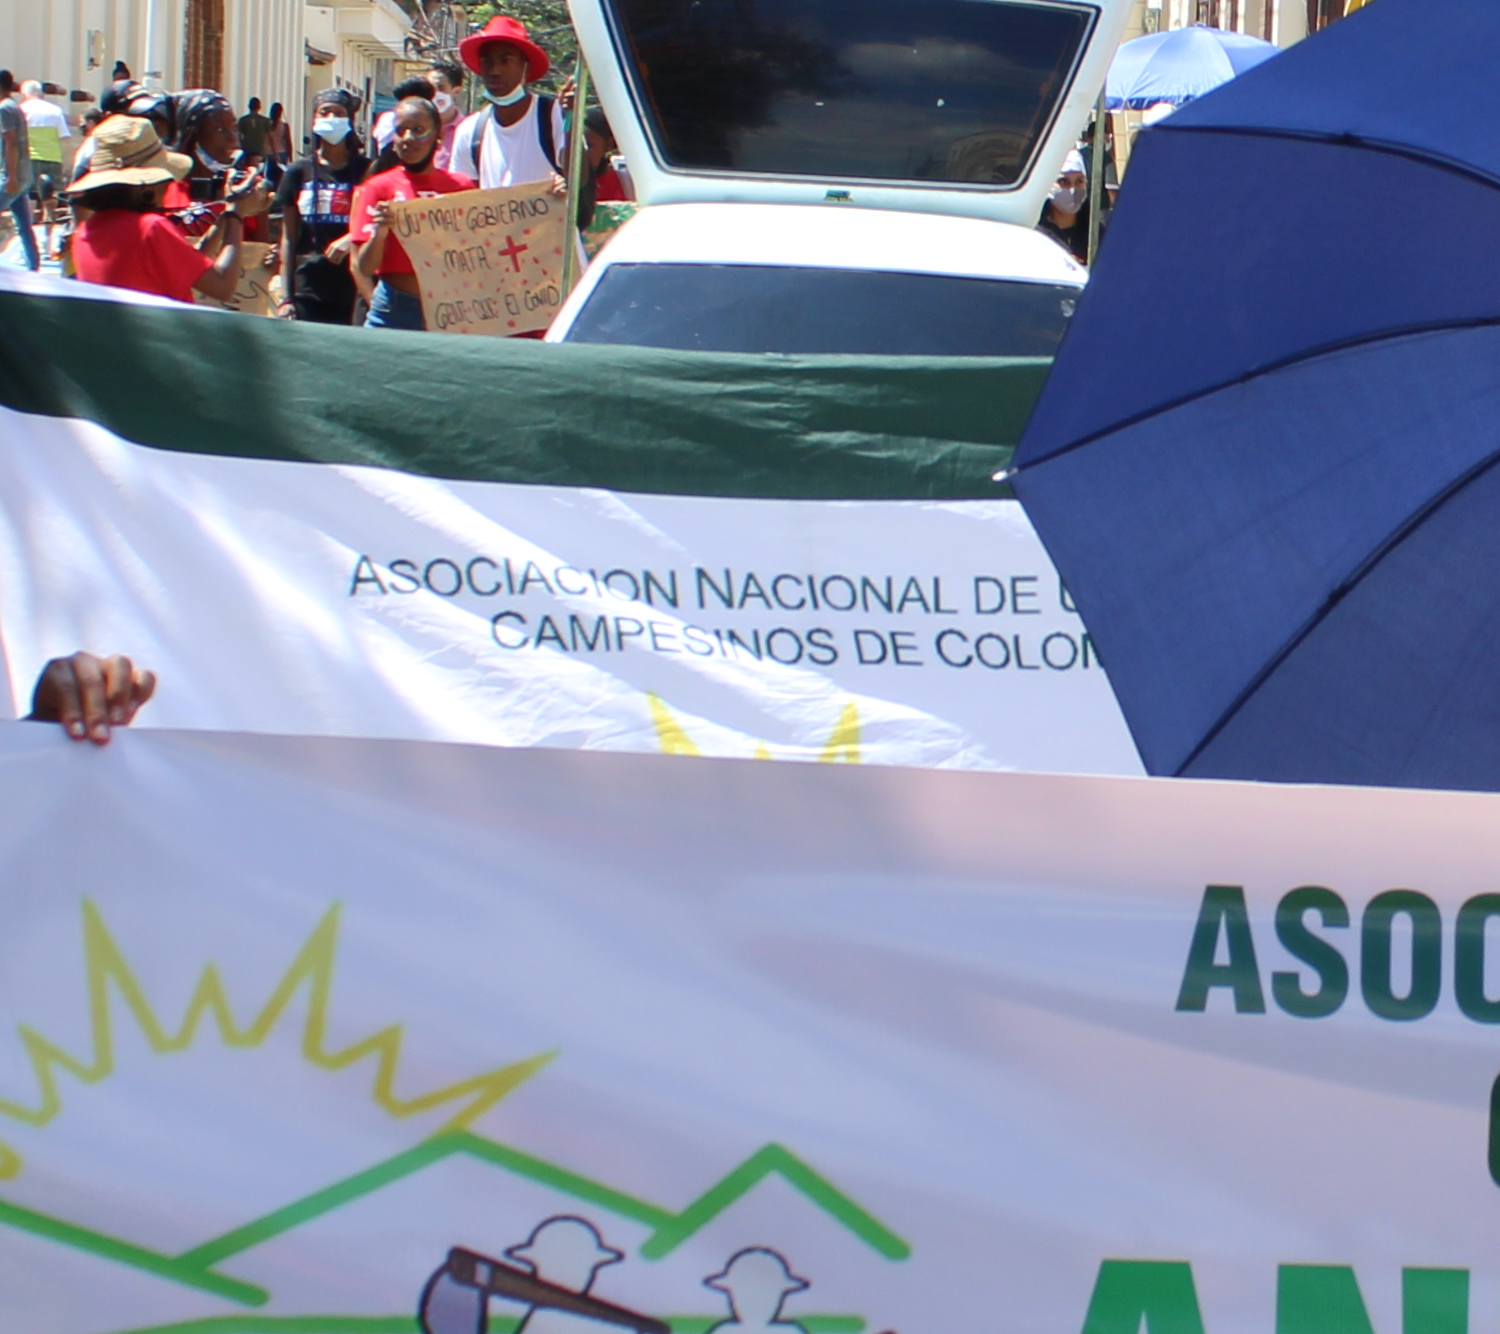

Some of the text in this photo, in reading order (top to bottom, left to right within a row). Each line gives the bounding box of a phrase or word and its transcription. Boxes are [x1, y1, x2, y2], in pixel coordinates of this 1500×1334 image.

[466, 197, 549, 231] GOBIERNO
[350, 553, 677, 610] ASOCIACION
[698, 566, 958, 616] NACIONAL
[974, 575, 1038, 616] DE
[491, 611, 841, 665] CAMPESINOS
[852, 630, 925, 666] DE
